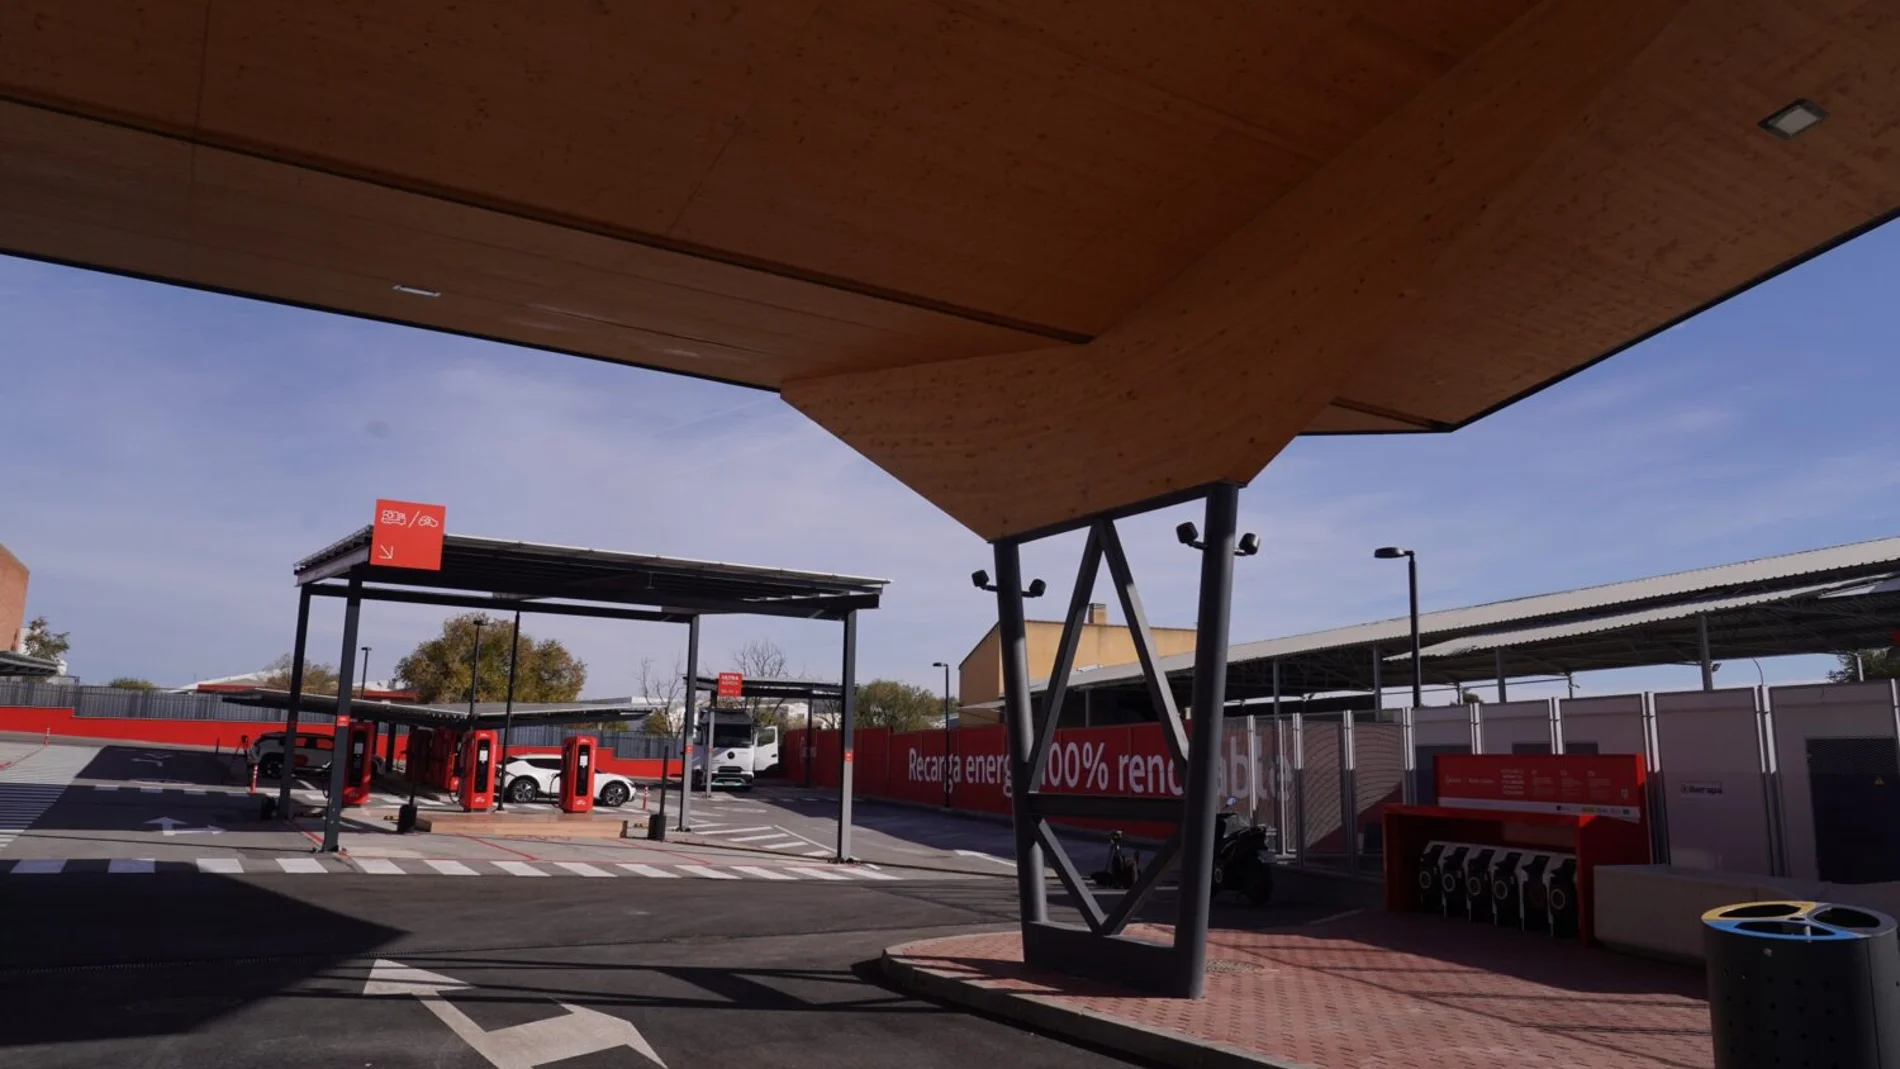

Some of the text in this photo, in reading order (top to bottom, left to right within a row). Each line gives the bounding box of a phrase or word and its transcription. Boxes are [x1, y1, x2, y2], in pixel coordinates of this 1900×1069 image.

[908, 747, 962, 794] Recarga
[965, 753, 1013, 797] energ
[1118, 735, 1292, 801] renoable
